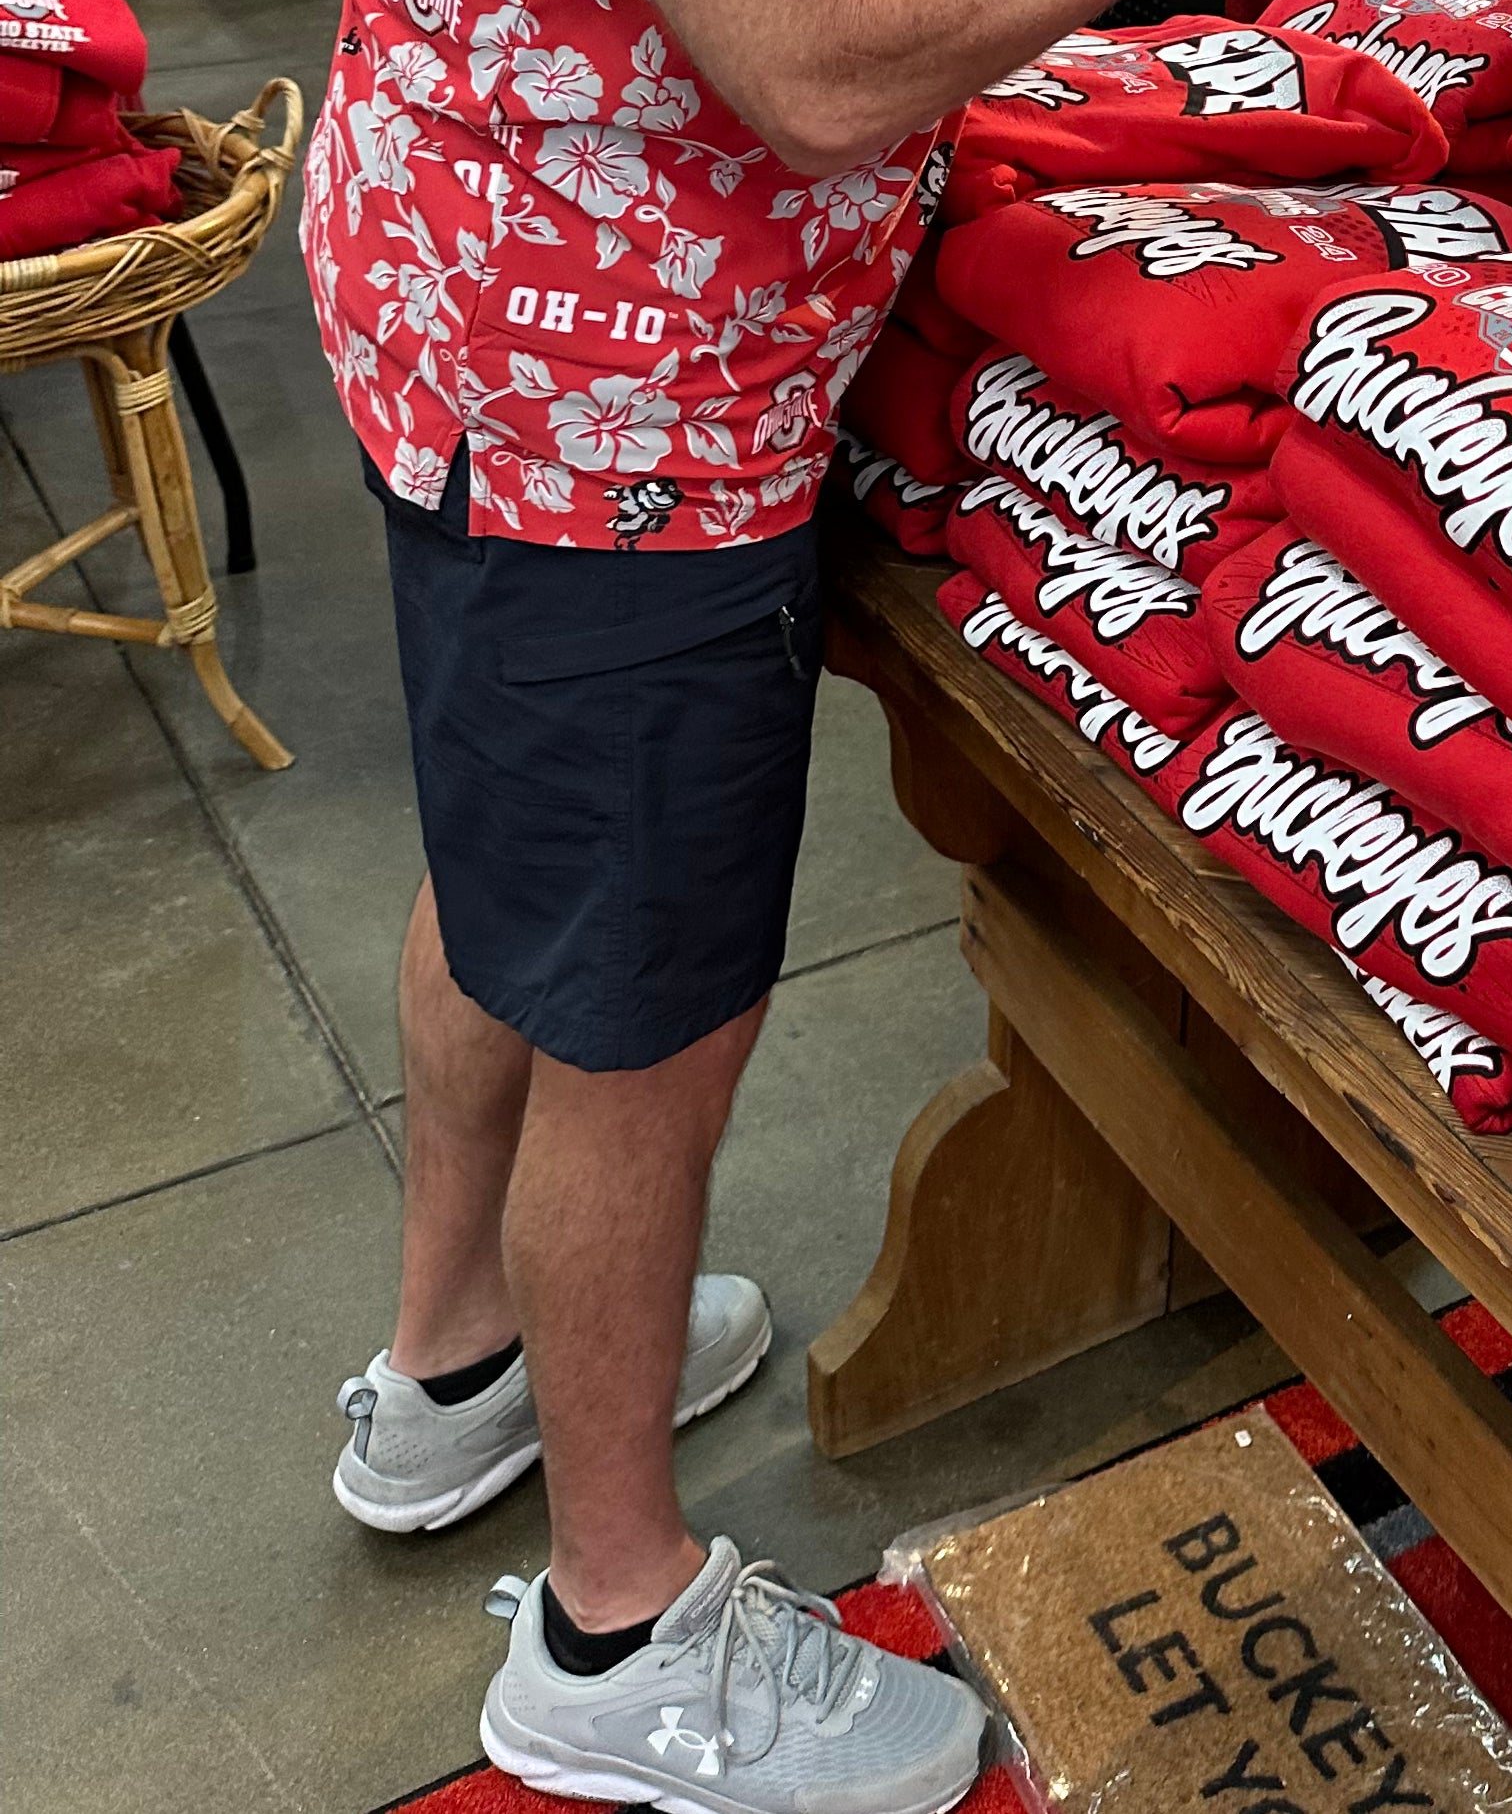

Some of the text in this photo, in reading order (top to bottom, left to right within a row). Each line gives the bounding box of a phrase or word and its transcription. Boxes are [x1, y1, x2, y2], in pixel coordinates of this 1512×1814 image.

[1288, 223, 1358, 262] 24
[1382, 189, 1506, 258] STA
[506, 285, 667, 345] OH-IO
[966, 354, 1228, 572] Buckeyes
[1087, 1589, 1233, 1728] LET
[1161, 1511, 1440, 1814] BUCKEY
